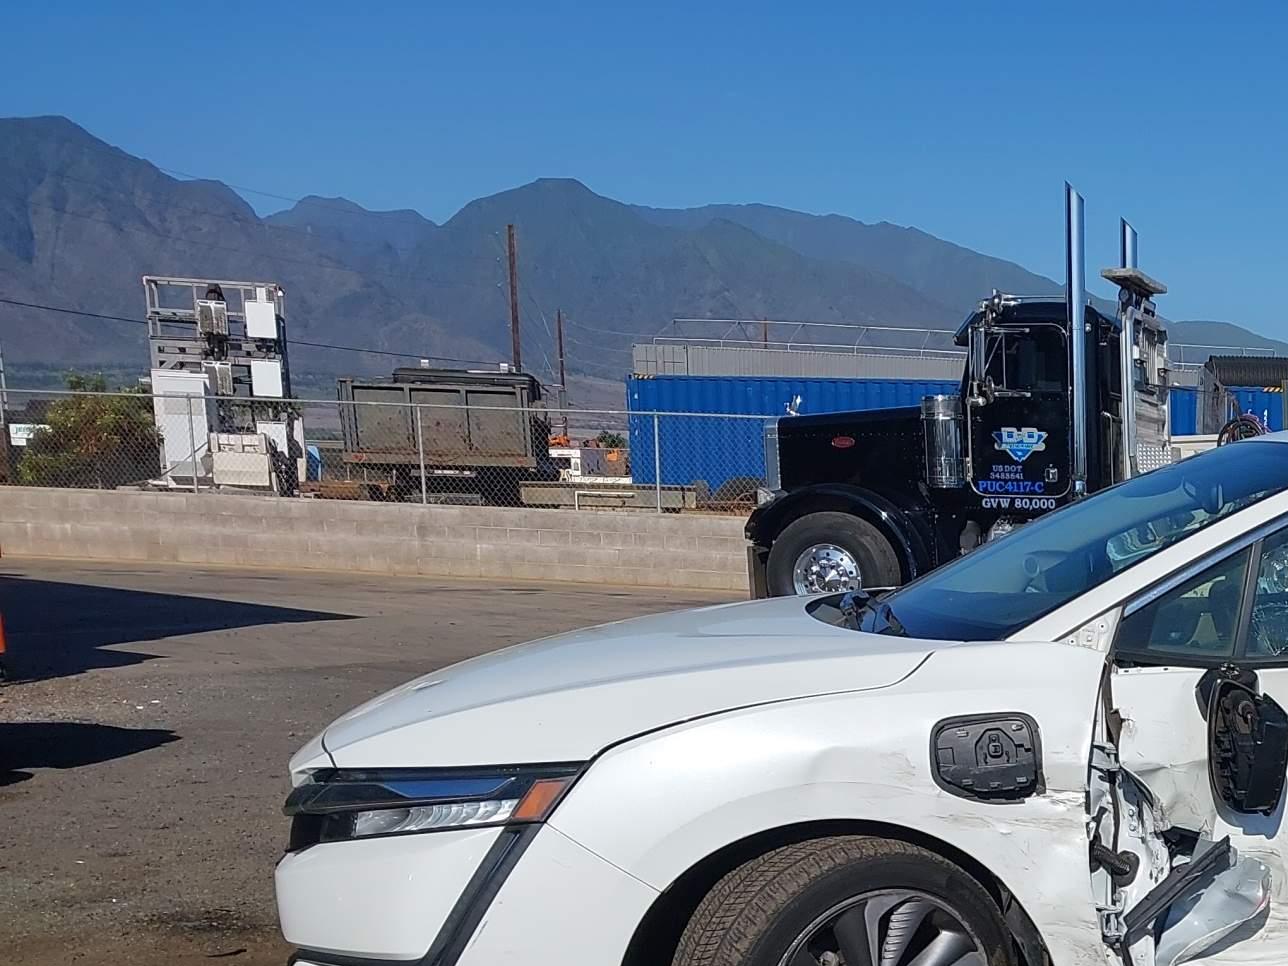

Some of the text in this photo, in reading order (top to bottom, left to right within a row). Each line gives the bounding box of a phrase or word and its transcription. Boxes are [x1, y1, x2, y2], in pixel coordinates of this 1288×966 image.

[978, 481, 1044, 493] PUC4117-C
[982, 498, 1056, 511] GVW 80,000
